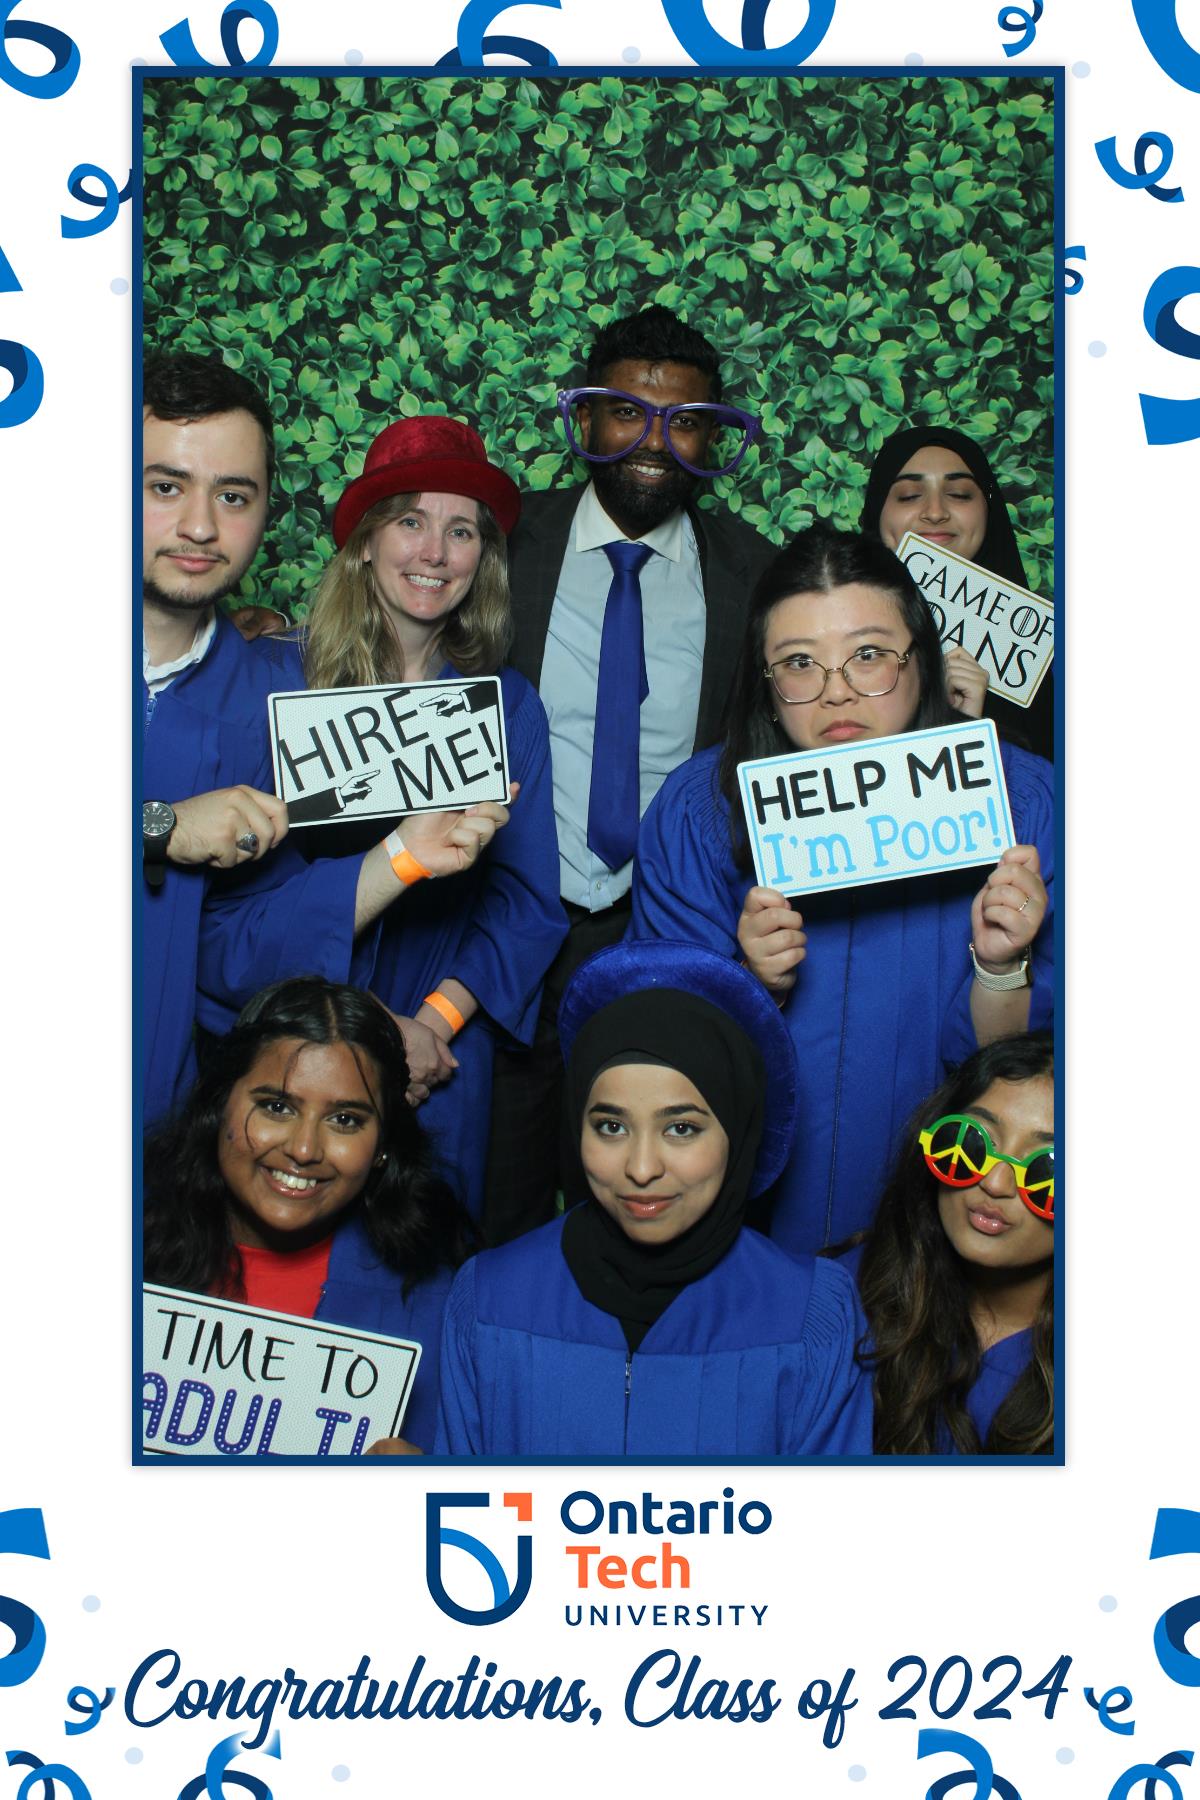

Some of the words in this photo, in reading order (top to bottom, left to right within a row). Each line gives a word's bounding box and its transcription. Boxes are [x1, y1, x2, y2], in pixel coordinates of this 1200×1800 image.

[903, 551, 1011, 626] GAME
[1010, 605, 1054, 646] OF
[279, 688, 430, 793] HIRE
[391, 721, 504, 810] ME!
[751, 760, 887, 825] HELP
[906, 740, 992, 798] ME
[762, 832, 857, 885] I'm
[865, 796, 1002, 868] Poor!
[157, 1308, 295, 1382] TIME
[316, 1343, 379, 1399] TO
